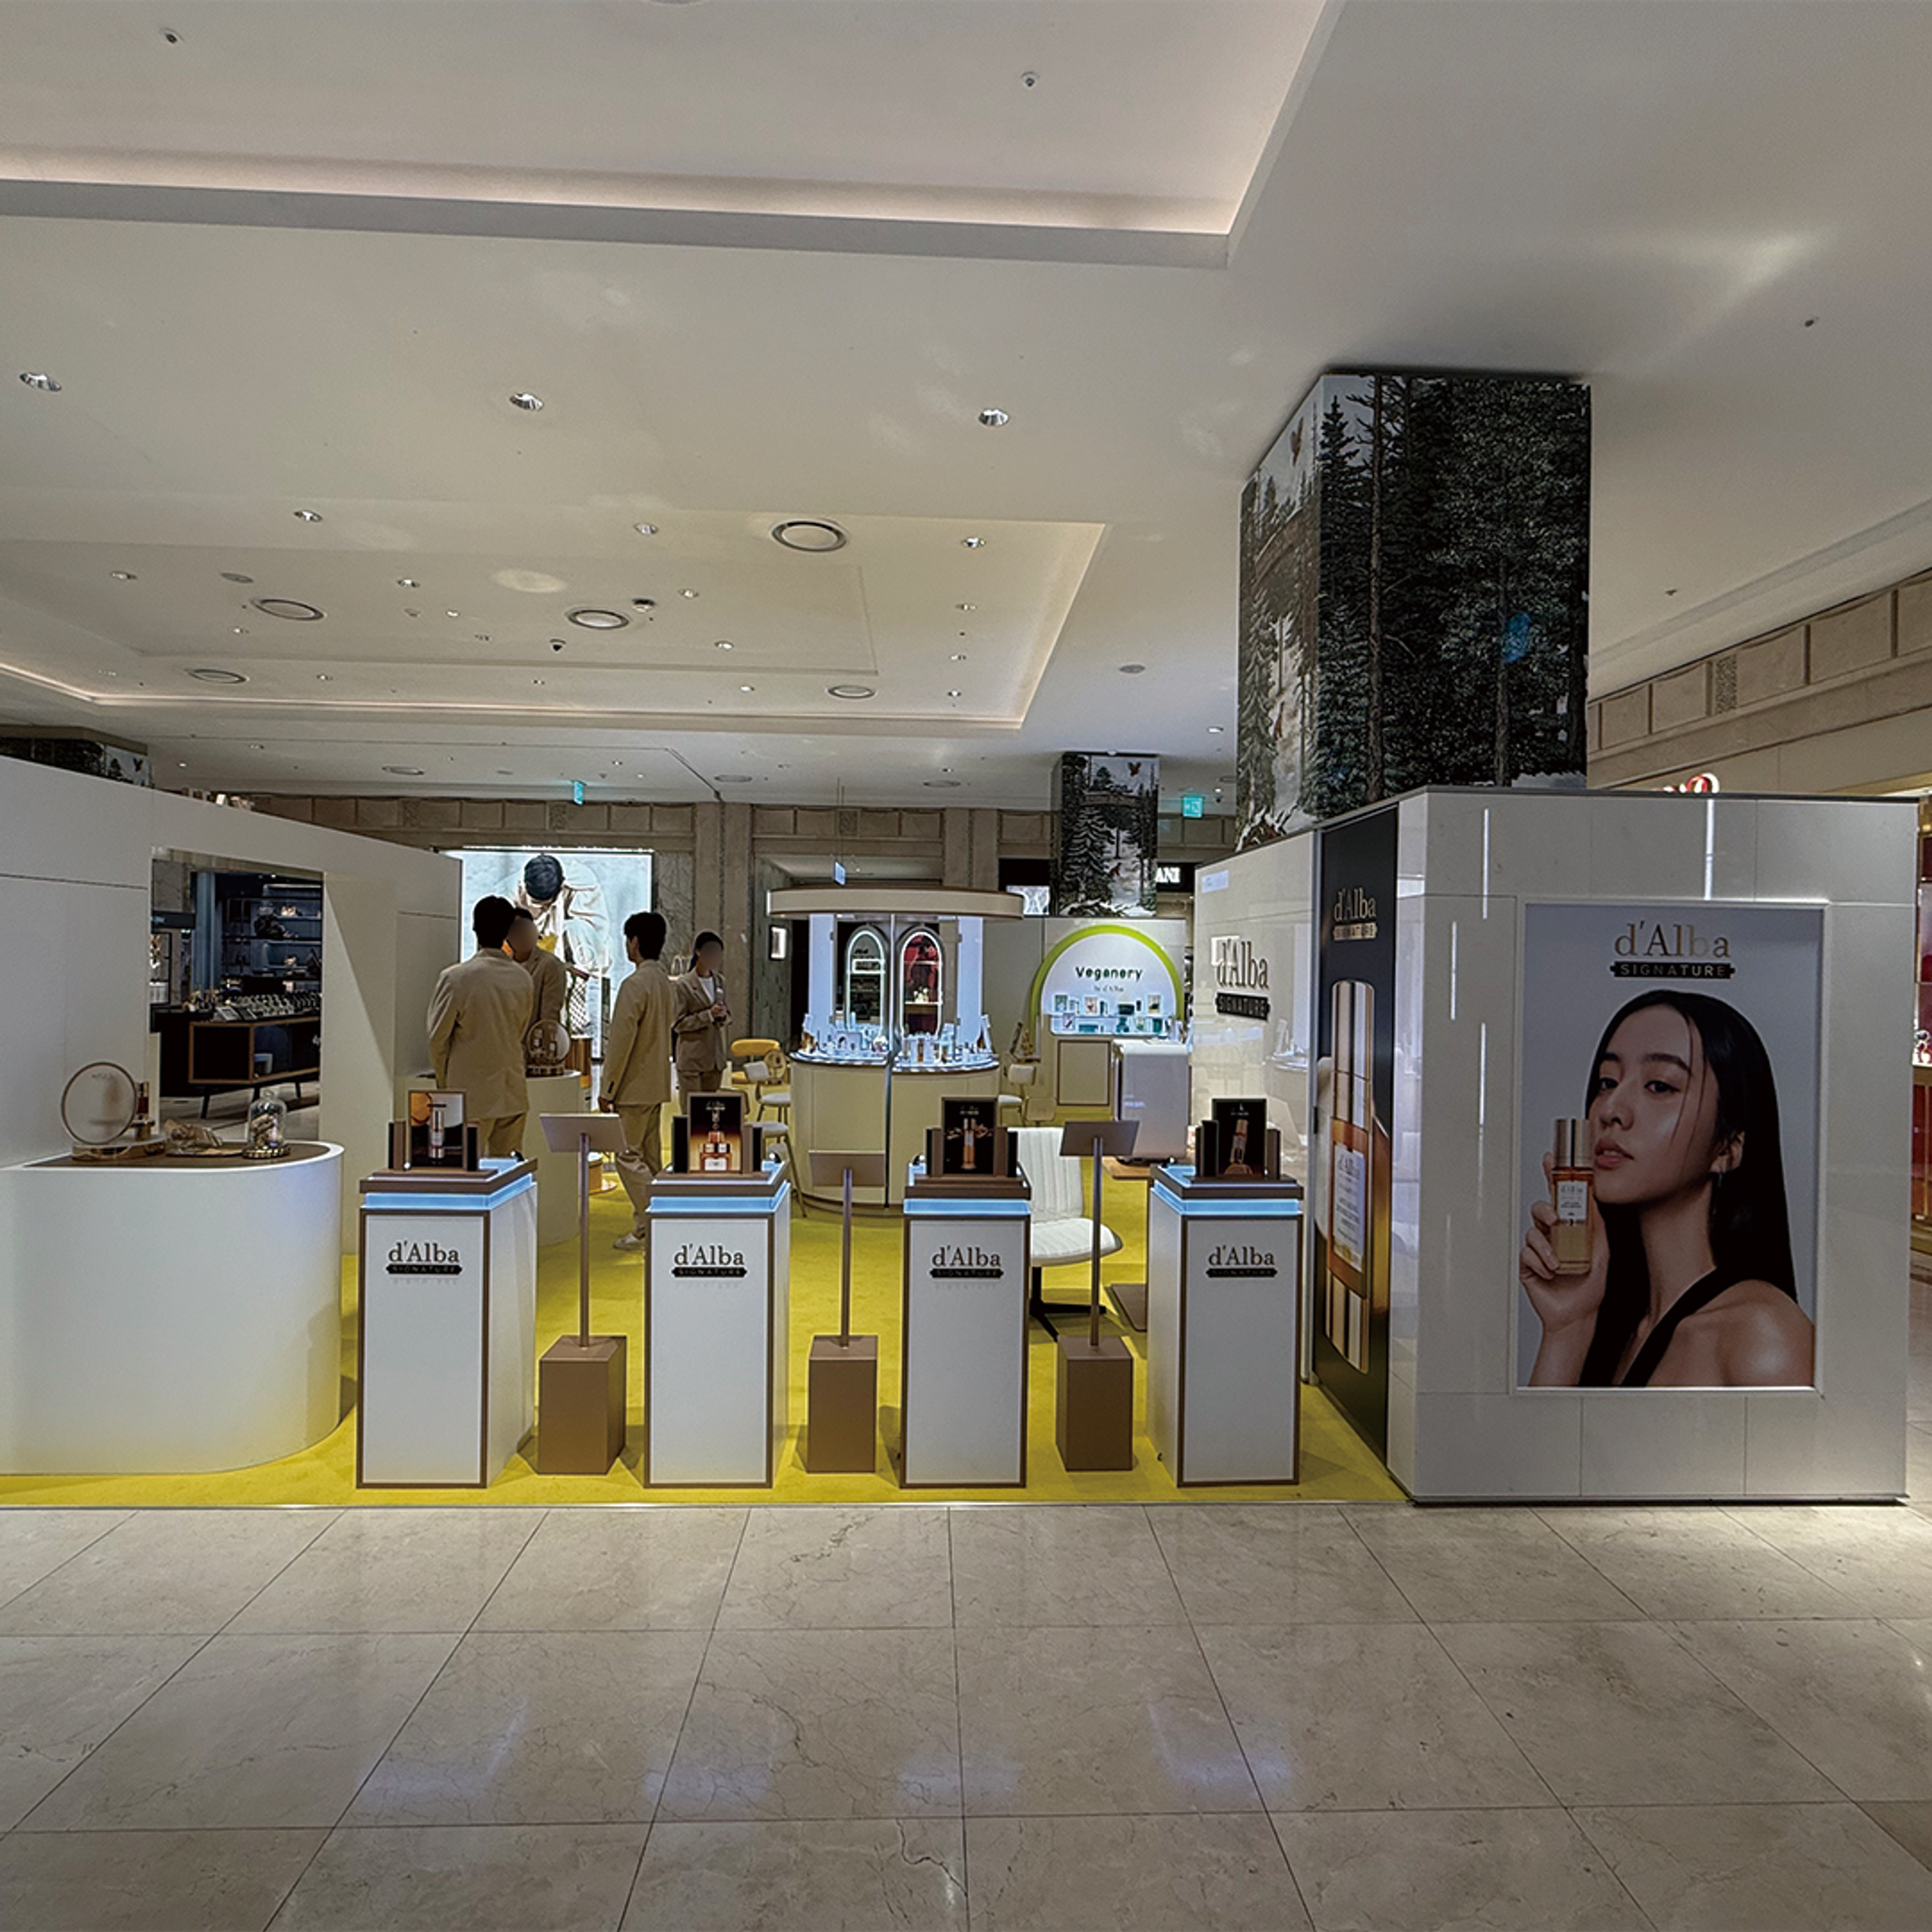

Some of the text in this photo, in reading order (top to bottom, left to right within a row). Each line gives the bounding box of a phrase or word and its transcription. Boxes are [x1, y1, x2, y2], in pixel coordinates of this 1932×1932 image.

[1334, 887, 1377, 922] d'Alba
[1615, 920, 1731, 958] d'Alba
[1217, 938, 1269, 990] d'Alba
[1620, 963, 1726, 977] SIGNATURE
[388, 1240, 461, 1263] d'Alba
[674, 1243, 745, 1265] d'Alba
[932, 1245, 1001, 1267] d'Alba
[1208, 1245, 1275, 1266] d'Alba
